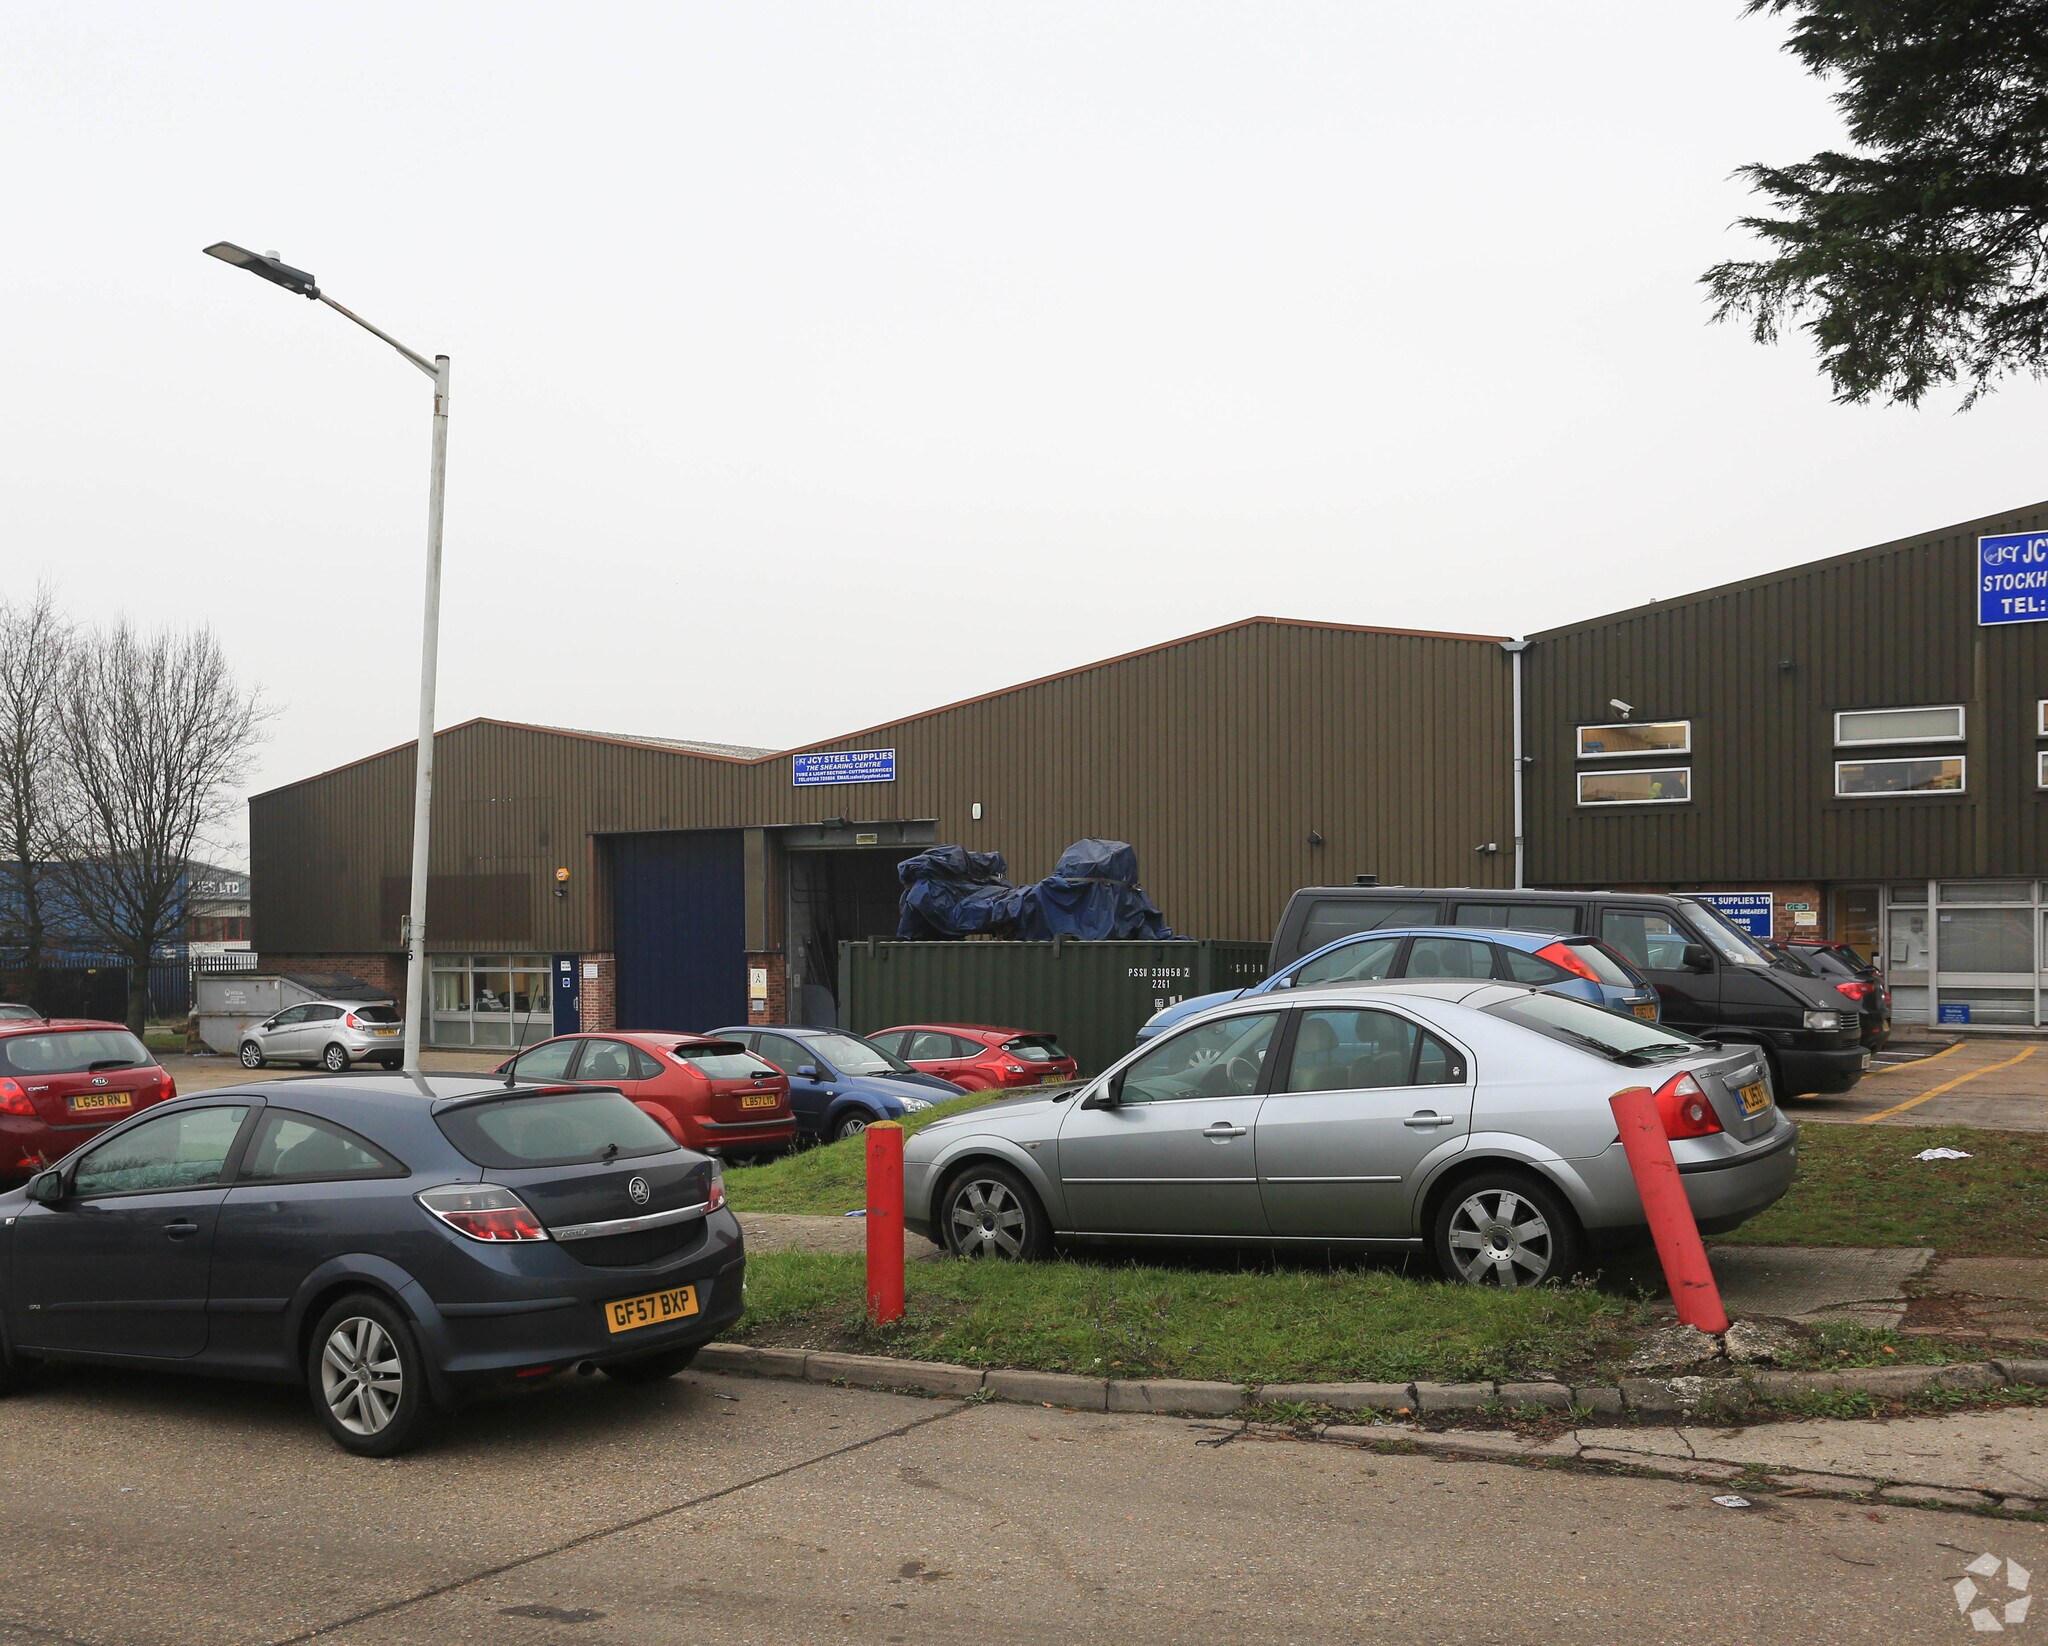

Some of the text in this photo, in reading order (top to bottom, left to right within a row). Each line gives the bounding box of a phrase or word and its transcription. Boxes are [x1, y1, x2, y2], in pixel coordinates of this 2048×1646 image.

[2022, 538, 2048, 564] JC
[2001, 596, 2046, 614] TEL:
[807, 751, 893, 764] JCY STEEL SUPPLIES
[820, 762, 853, 770] SHEARING
[219, 882, 240, 894] LTD
[1718, 896, 1754, 905] SUPPLIES
[1756, 896, 1771, 905] LTD
[1128, 967, 1148, 978] PSSU
[1183, 967, 1190, 978] 2
[1152, 979, 1170, 989] 22G1
[76, 1093, 128, 1108] LG58 RNJ
[613, 1289, 689, 1326] GF57 BXP
